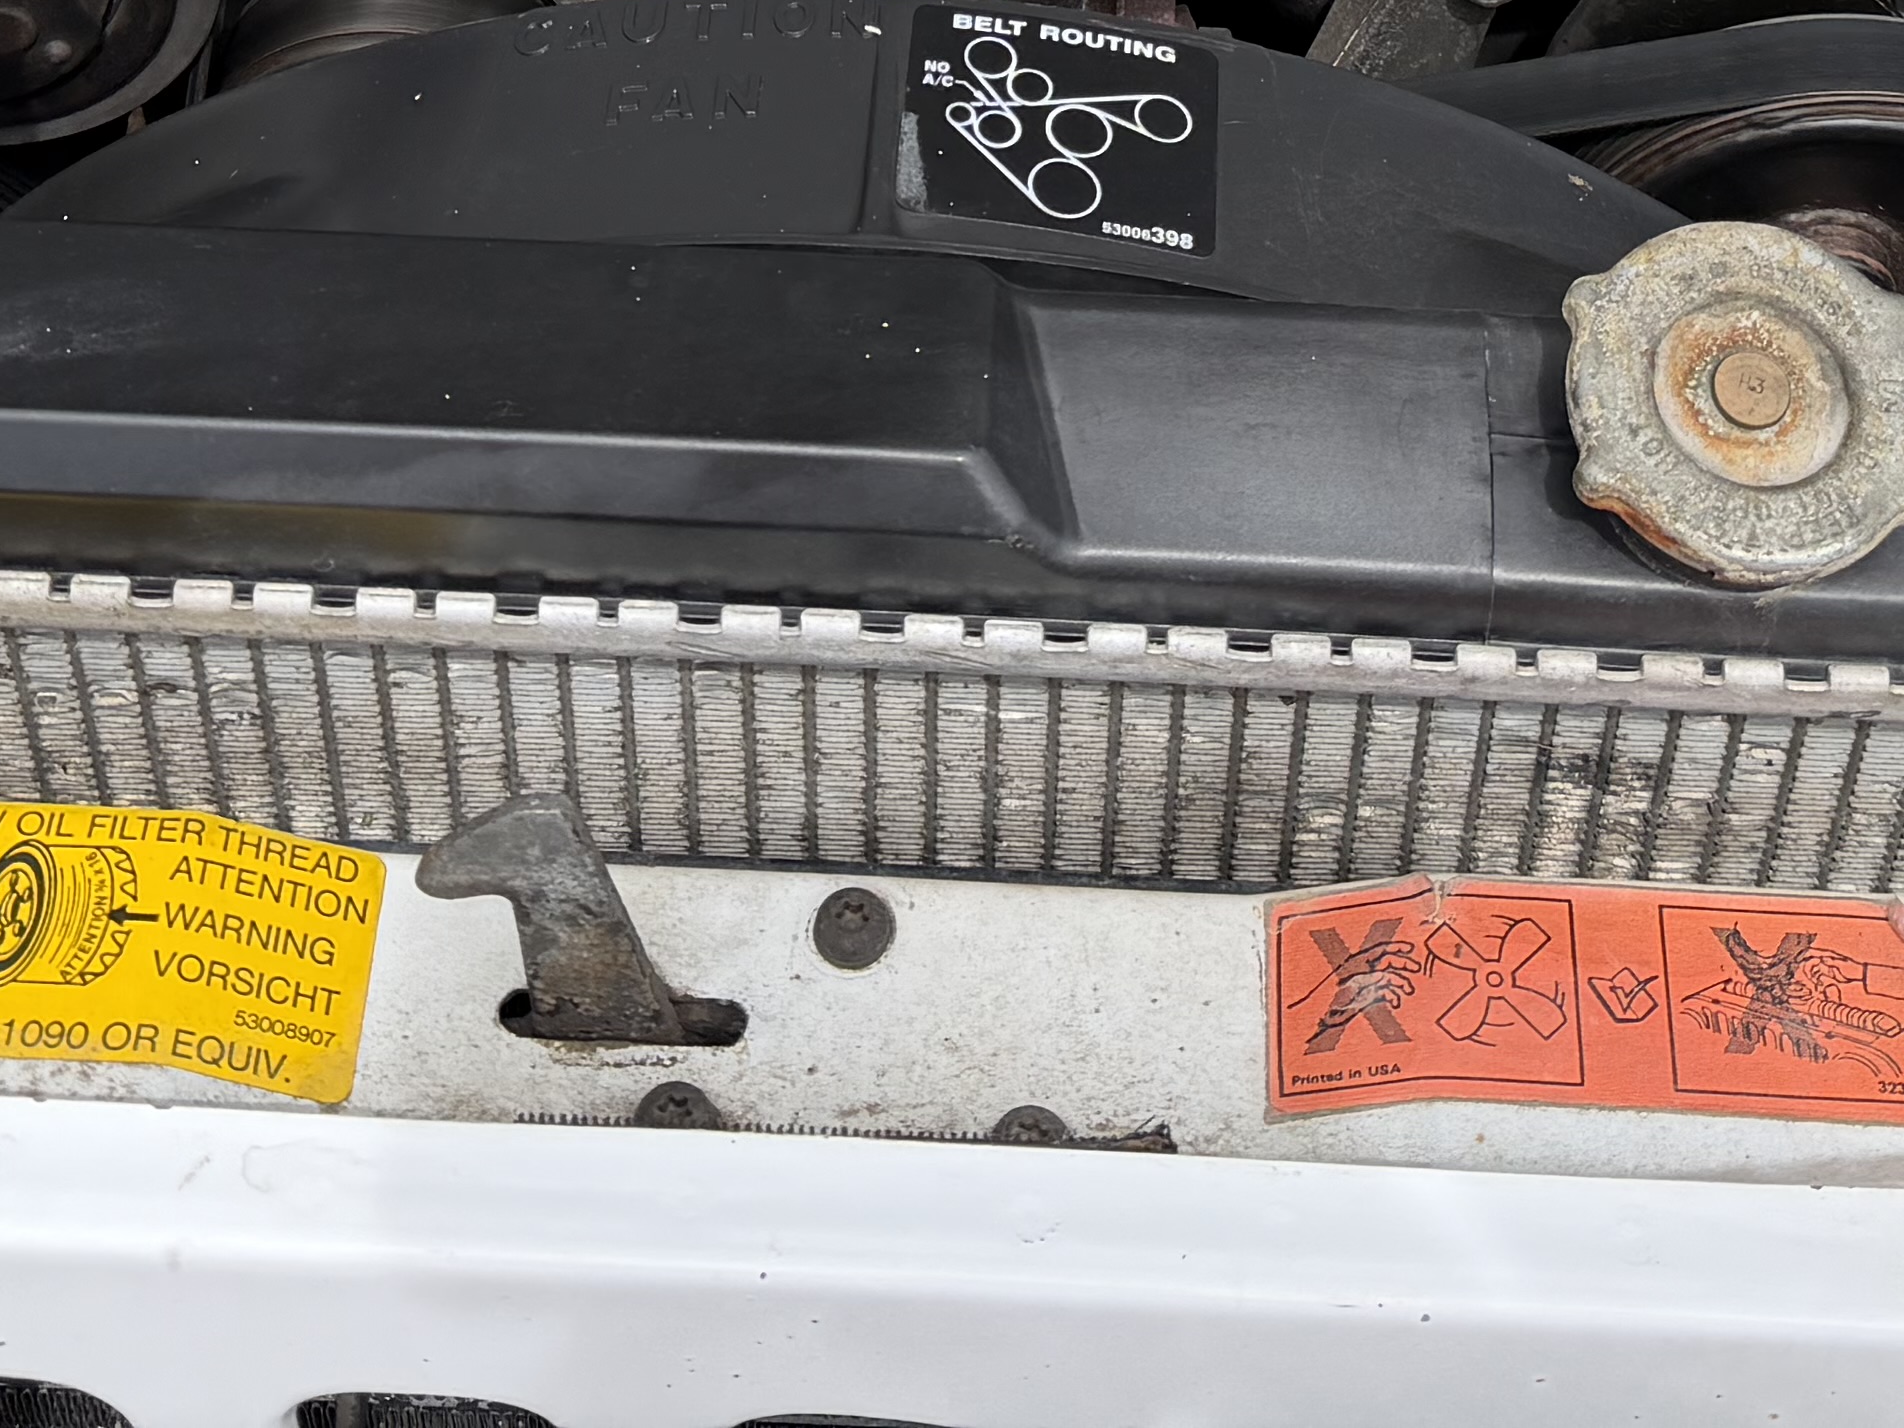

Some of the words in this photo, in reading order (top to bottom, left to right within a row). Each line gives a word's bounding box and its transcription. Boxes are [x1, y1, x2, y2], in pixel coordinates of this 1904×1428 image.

[924, 60, 950, 74] NO
[952, 13, 1028, 37] BELT
[1039, 24, 1177, 64] ROUTING
[603, 74, 766, 127] FAN
[922, 74, 954, 88] A/C
[16, 811, 74, 837] OIL
[87, 813, 205, 845] FILTER
[218, 824, 359, 883] THREAD
[169, 855, 369, 924] ATTENTION
[60, 896, 108, 983] ATTENTION
[165, 901, 336, 966] WARNING
[154, 949, 341, 1016] VORSICHT
[102, 1022, 159, 1052] OR
[172, 1029, 291, 1083] EQUIV.
[233, 1010, 336, 1048] 53008907
[1292, 1071, 1343, 1086] Printed
[1348, 1069, 1362, 1079] in
[1368, 1063, 1401, 1077] USA
